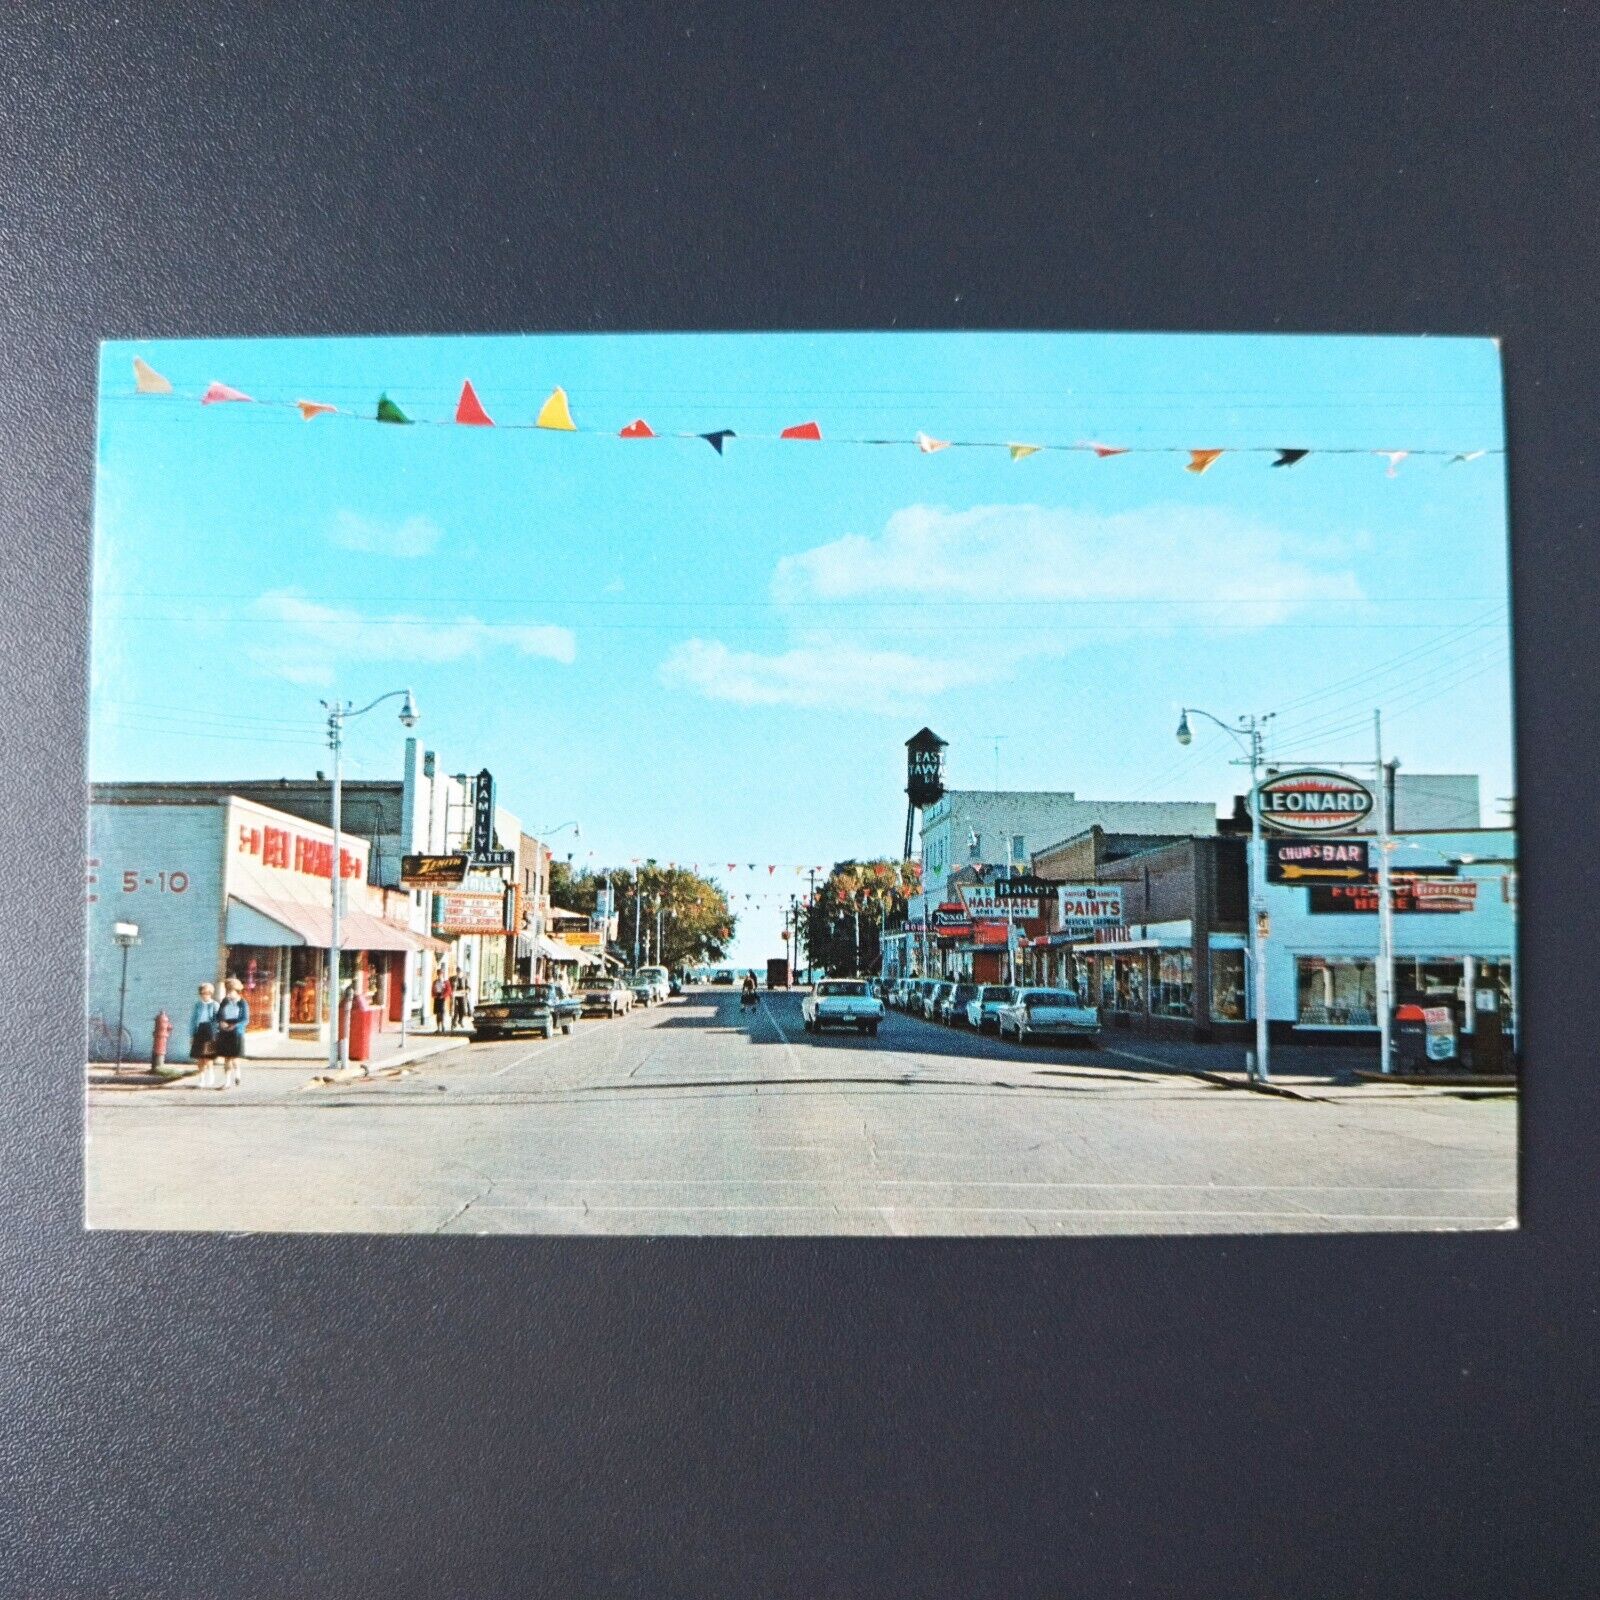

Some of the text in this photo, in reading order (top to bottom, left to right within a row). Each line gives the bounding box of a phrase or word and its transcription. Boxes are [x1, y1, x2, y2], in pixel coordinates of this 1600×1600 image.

[915, 751, 944, 763] EAST
[1260, 792, 1367, 811] LEONARD
[478, 777, 489, 847] FAMILY
[1322, 844, 1363, 861] BAR
[123, 871, 189, 894] 5-10
[1000, 908, 1030, 916] PANTS
[1064, 900, 1121, 916] PAINTS
